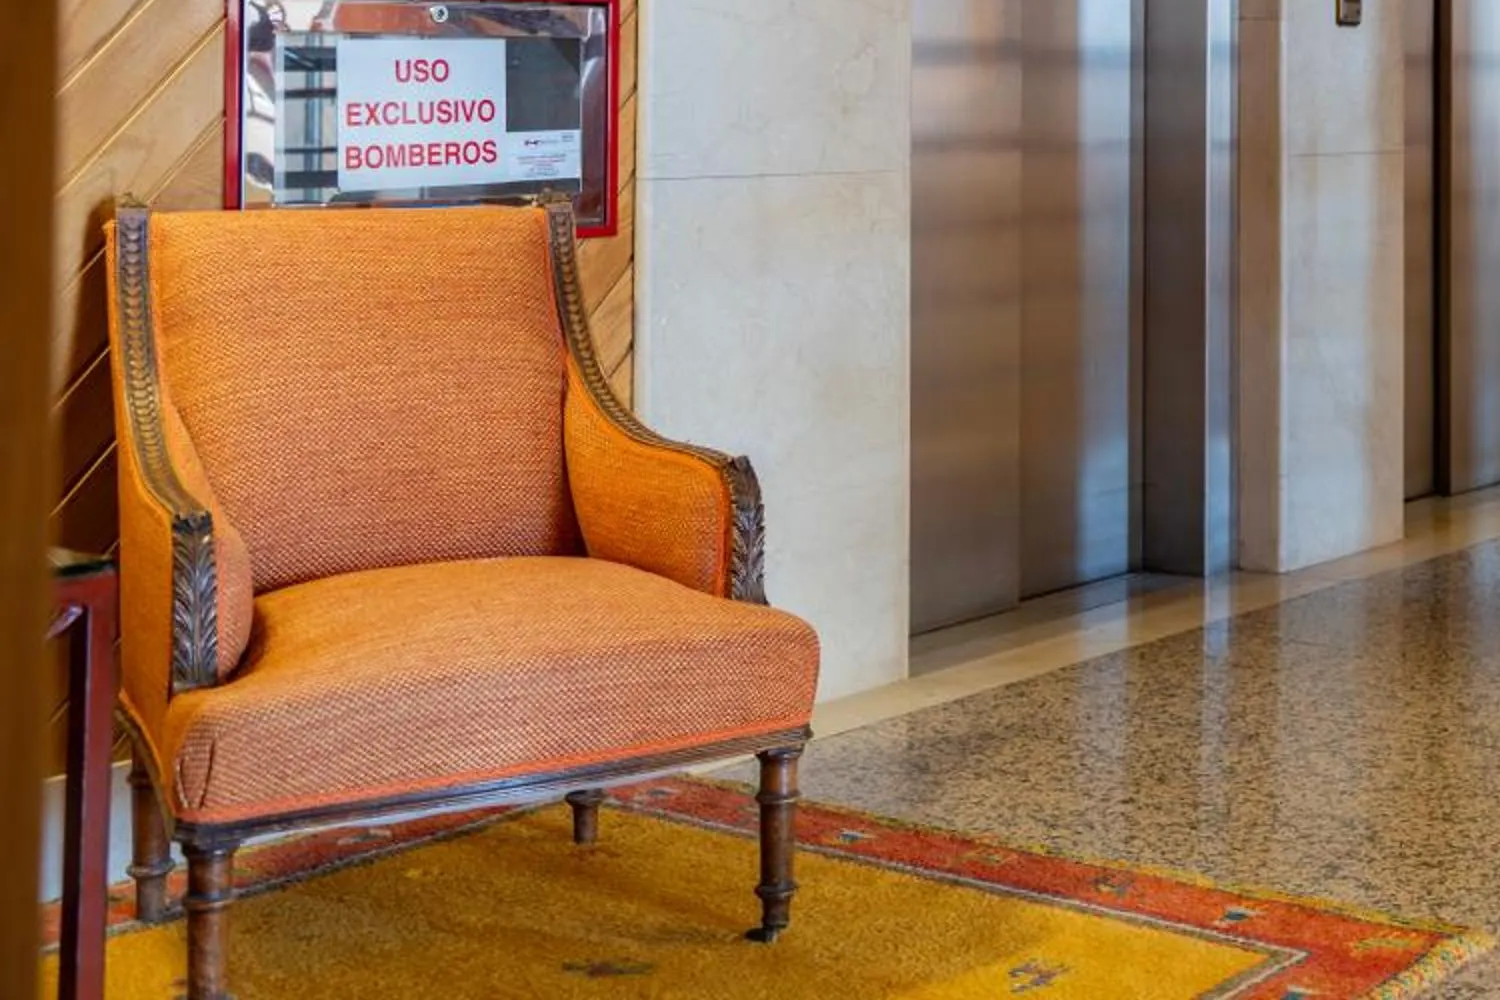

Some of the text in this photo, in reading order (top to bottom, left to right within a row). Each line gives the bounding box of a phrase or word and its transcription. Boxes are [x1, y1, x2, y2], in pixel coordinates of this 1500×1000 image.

[395, 58, 449, 83] USO
[345, 99, 496, 127] EXCLUSIVO
[345, 139, 497, 169] BOMBEROS
